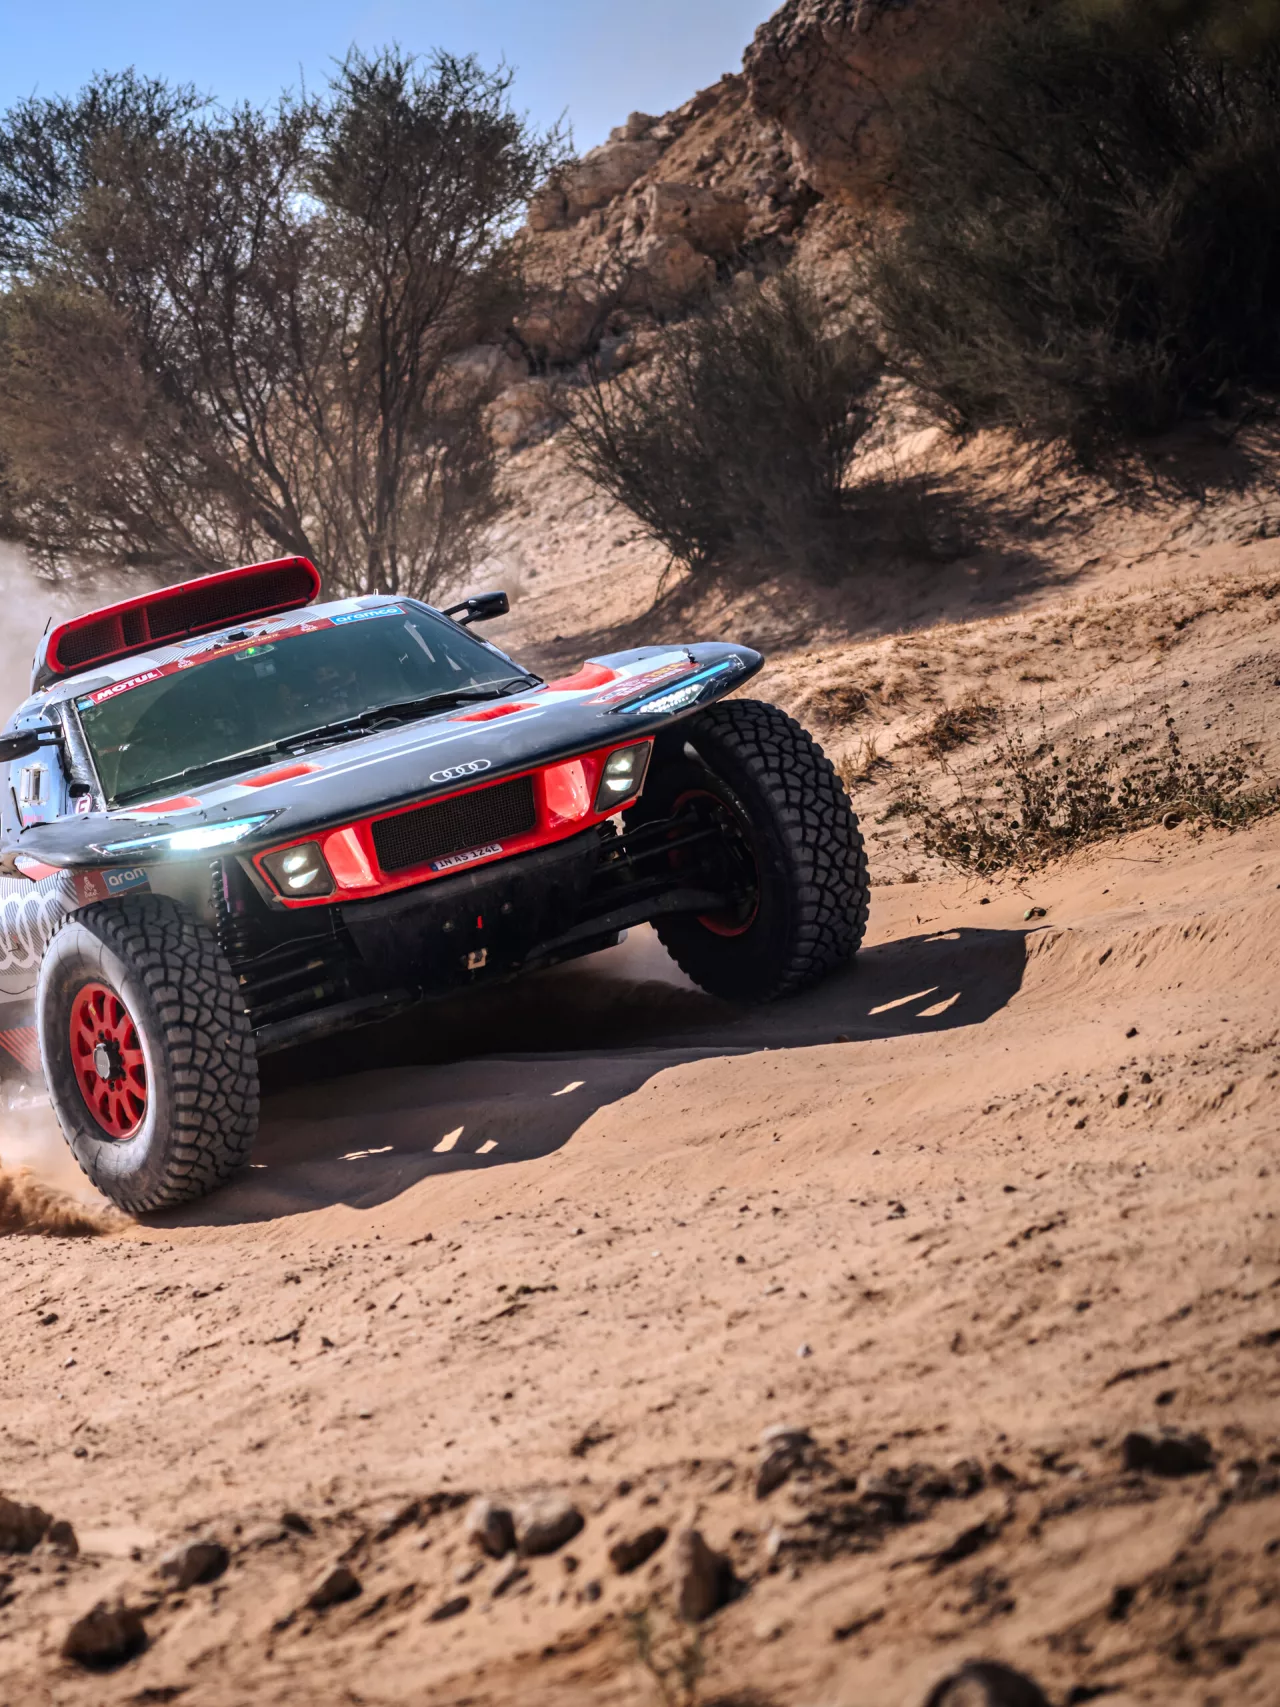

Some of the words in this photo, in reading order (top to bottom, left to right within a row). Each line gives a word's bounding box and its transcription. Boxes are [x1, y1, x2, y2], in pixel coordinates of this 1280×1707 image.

[335, 608, 398, 623] aramco
[96, 671, 158, 701] MOTUL
[454, 853, 469, 863] AS
[471, 845, 500, 858] 124E
